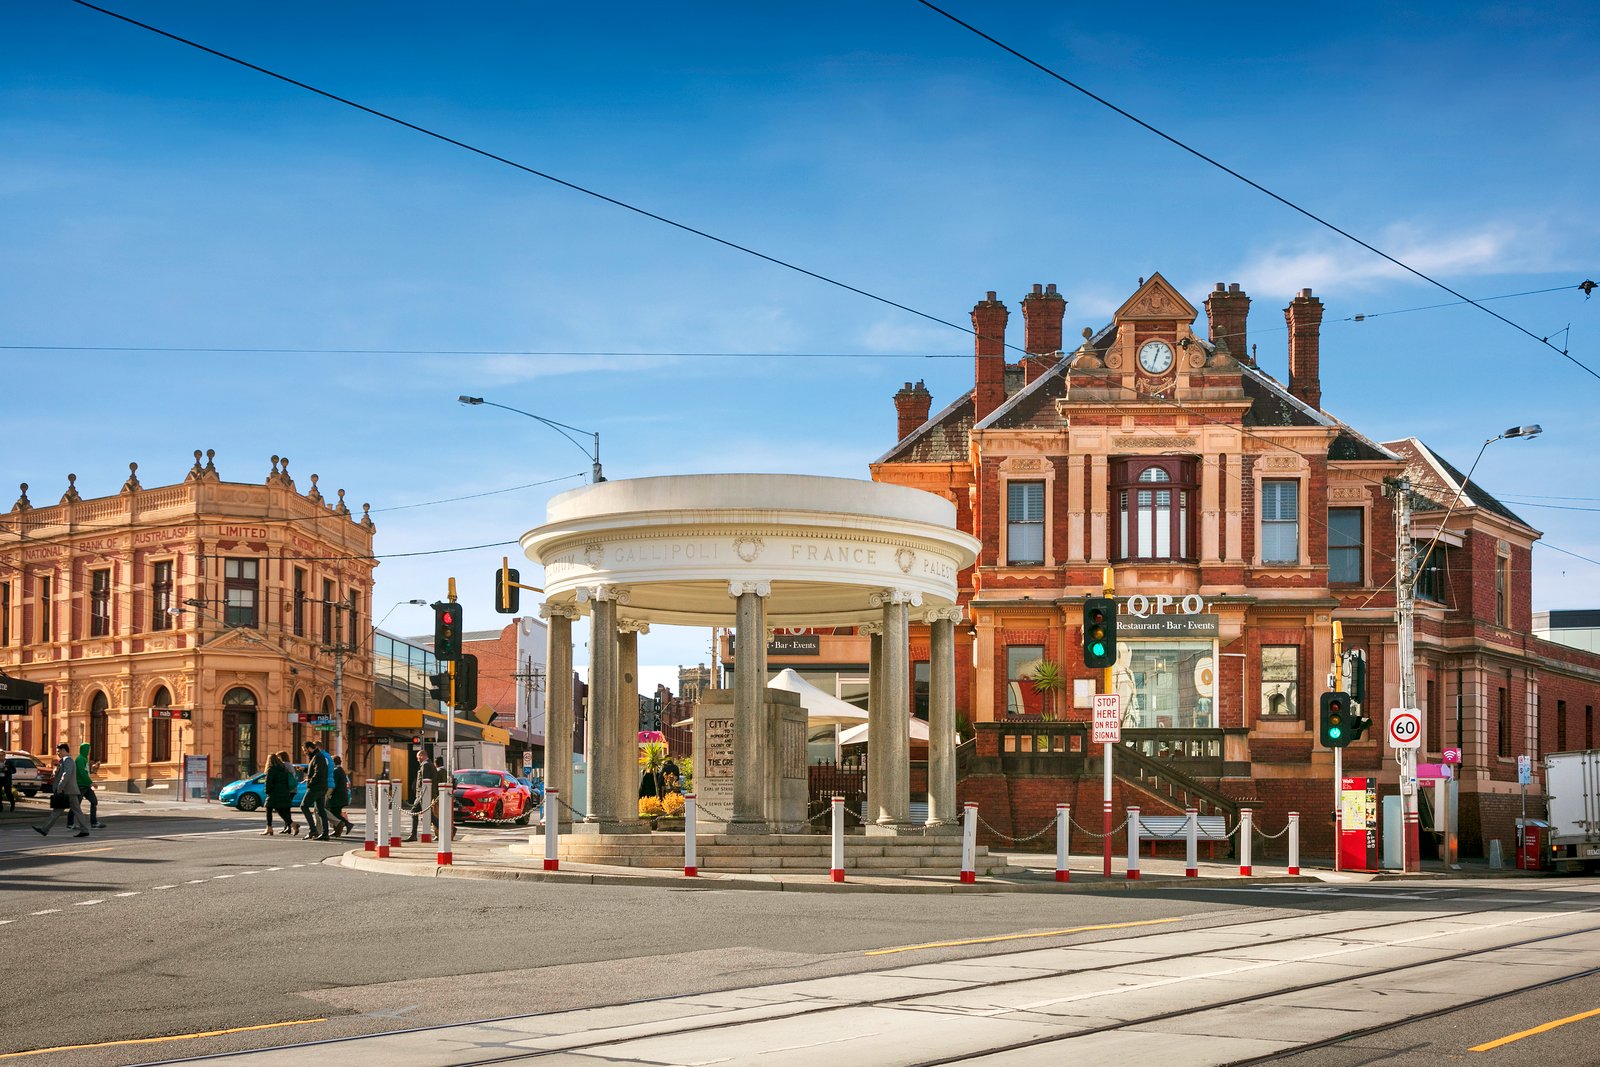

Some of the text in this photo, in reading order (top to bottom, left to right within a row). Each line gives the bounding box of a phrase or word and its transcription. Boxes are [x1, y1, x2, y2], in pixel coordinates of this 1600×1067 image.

[218, 526, 266, 538] LIMITED
[0, 526, 188, 562] HE NATIONAL BANK OF AUSTRALASIA
[615, 543, 718, 563] GALLIPOLI
[791, 544, 876, 565] FRANCE
[1116, 621, 1215, 630] Restaurant Bar Events
[775, 640, 787, 649] Bar
[793, 640, 816, 649] Events
[1097, 698, 1116, 707] STOP
[1097, 710, 1117, 718] HERE
[1396, 722, 1415, 734] 60
